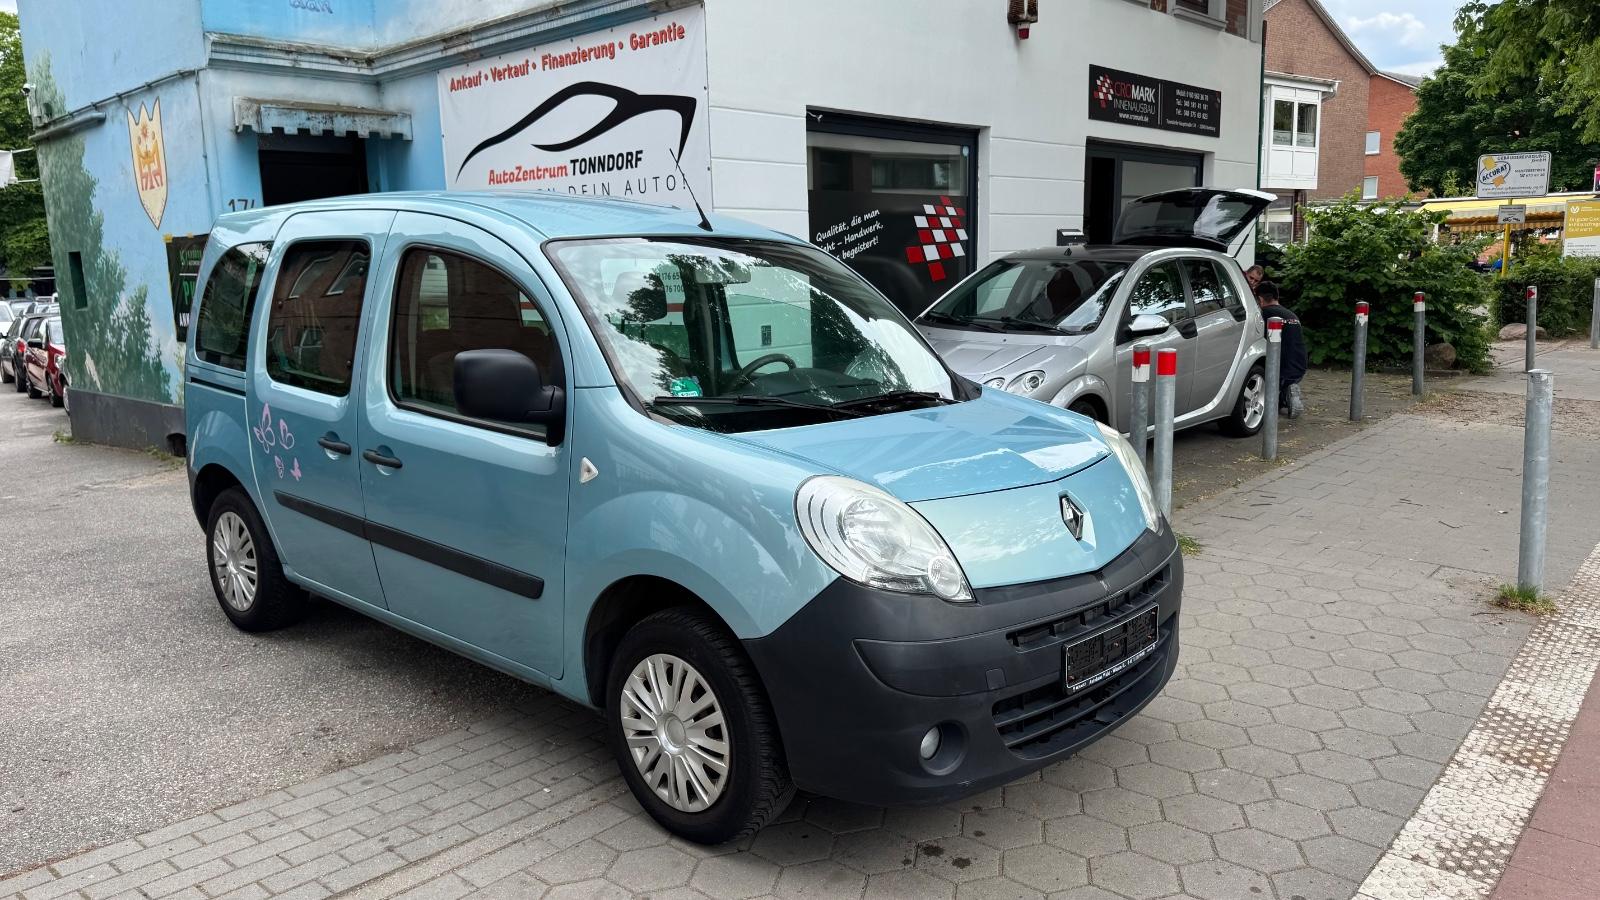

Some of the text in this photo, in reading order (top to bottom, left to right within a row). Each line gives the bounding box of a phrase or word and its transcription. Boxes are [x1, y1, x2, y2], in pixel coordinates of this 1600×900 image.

[450, 22, 686, 92] Ankauf Verkauf Finanzierung Garantie
[1114, 82, 1155, 103] CROMARK
[1113, 98, 1156, 115] INNENAUSBAU
[488, 150, 643, 186] AutoZentrum TONNDORF
[1481, 163, 1508, 182] ACCURAT
[624, 173, 687, 195] AUTO!
[815, 209, 880, 242] Qualität, die man
[844, 220, 884, 243] Handwerk,
[842, 236, 878, 259] begeistert!
